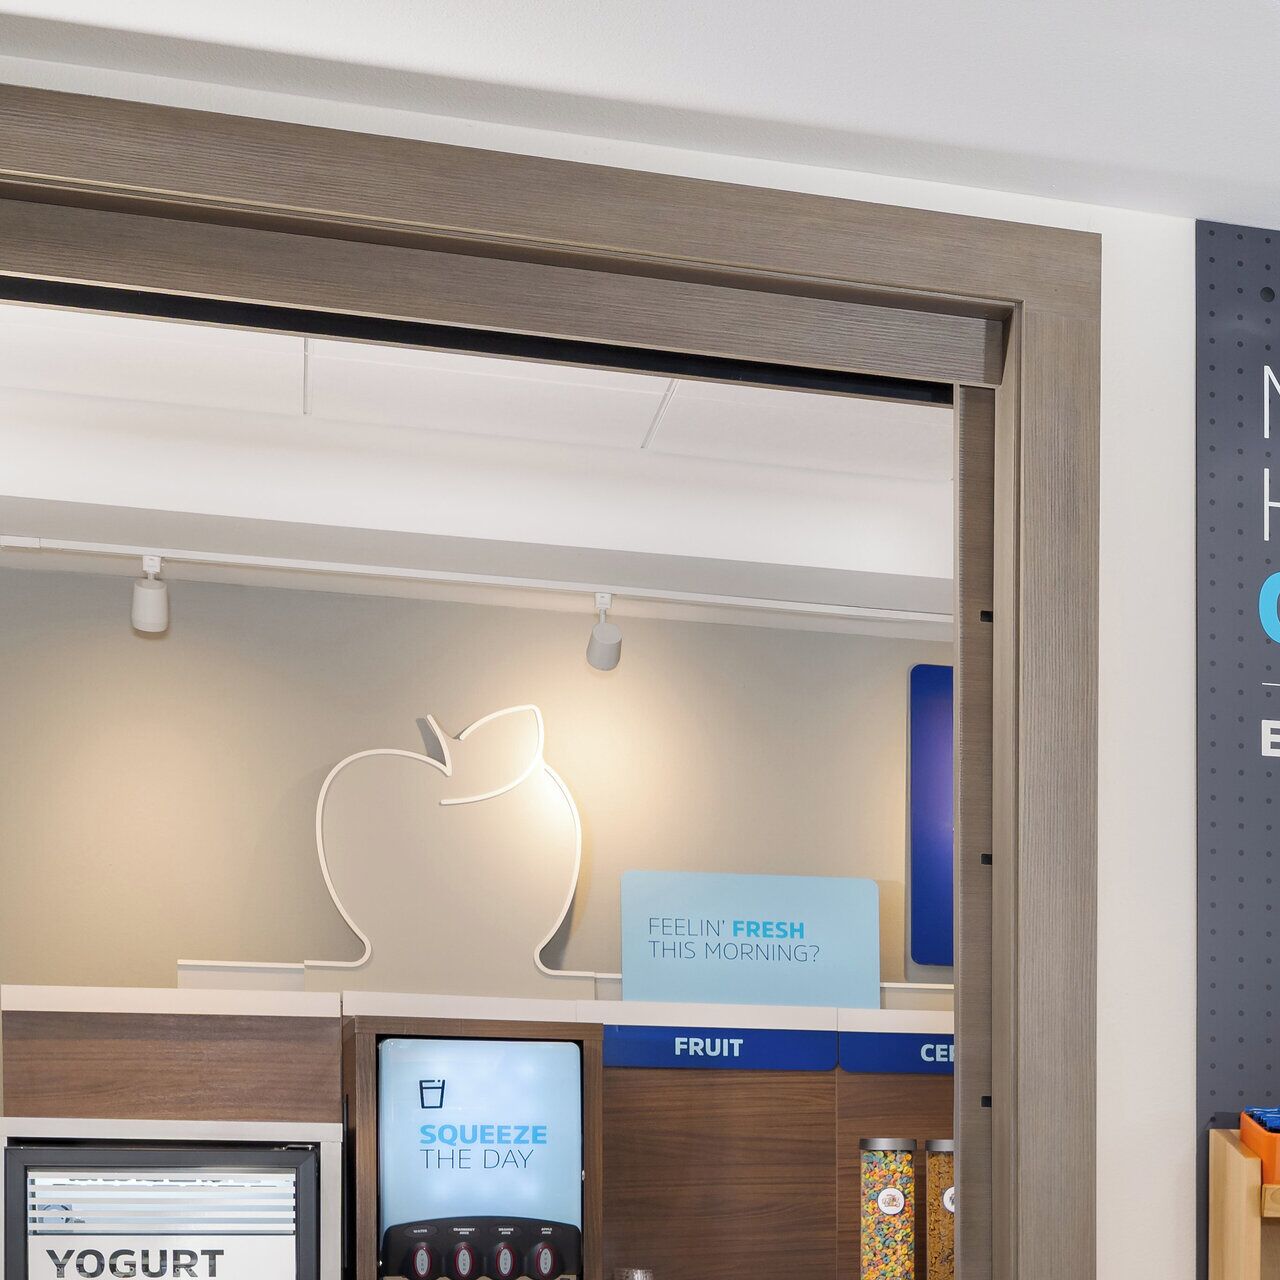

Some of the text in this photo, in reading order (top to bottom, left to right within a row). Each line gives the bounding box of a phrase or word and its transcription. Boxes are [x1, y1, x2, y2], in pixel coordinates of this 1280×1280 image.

[648, 917, 805, 940] FEELIN' FRESH
[648, 940, 820, 963] THIS MORNING?
[674, 1037, 744, 1057] FRUIT
[420, 1124, 548, 1146] SQUEEZE
[420, 1149, 534, 1169] THE DAY
[46, 1249, 225, 1279] YOGURT
